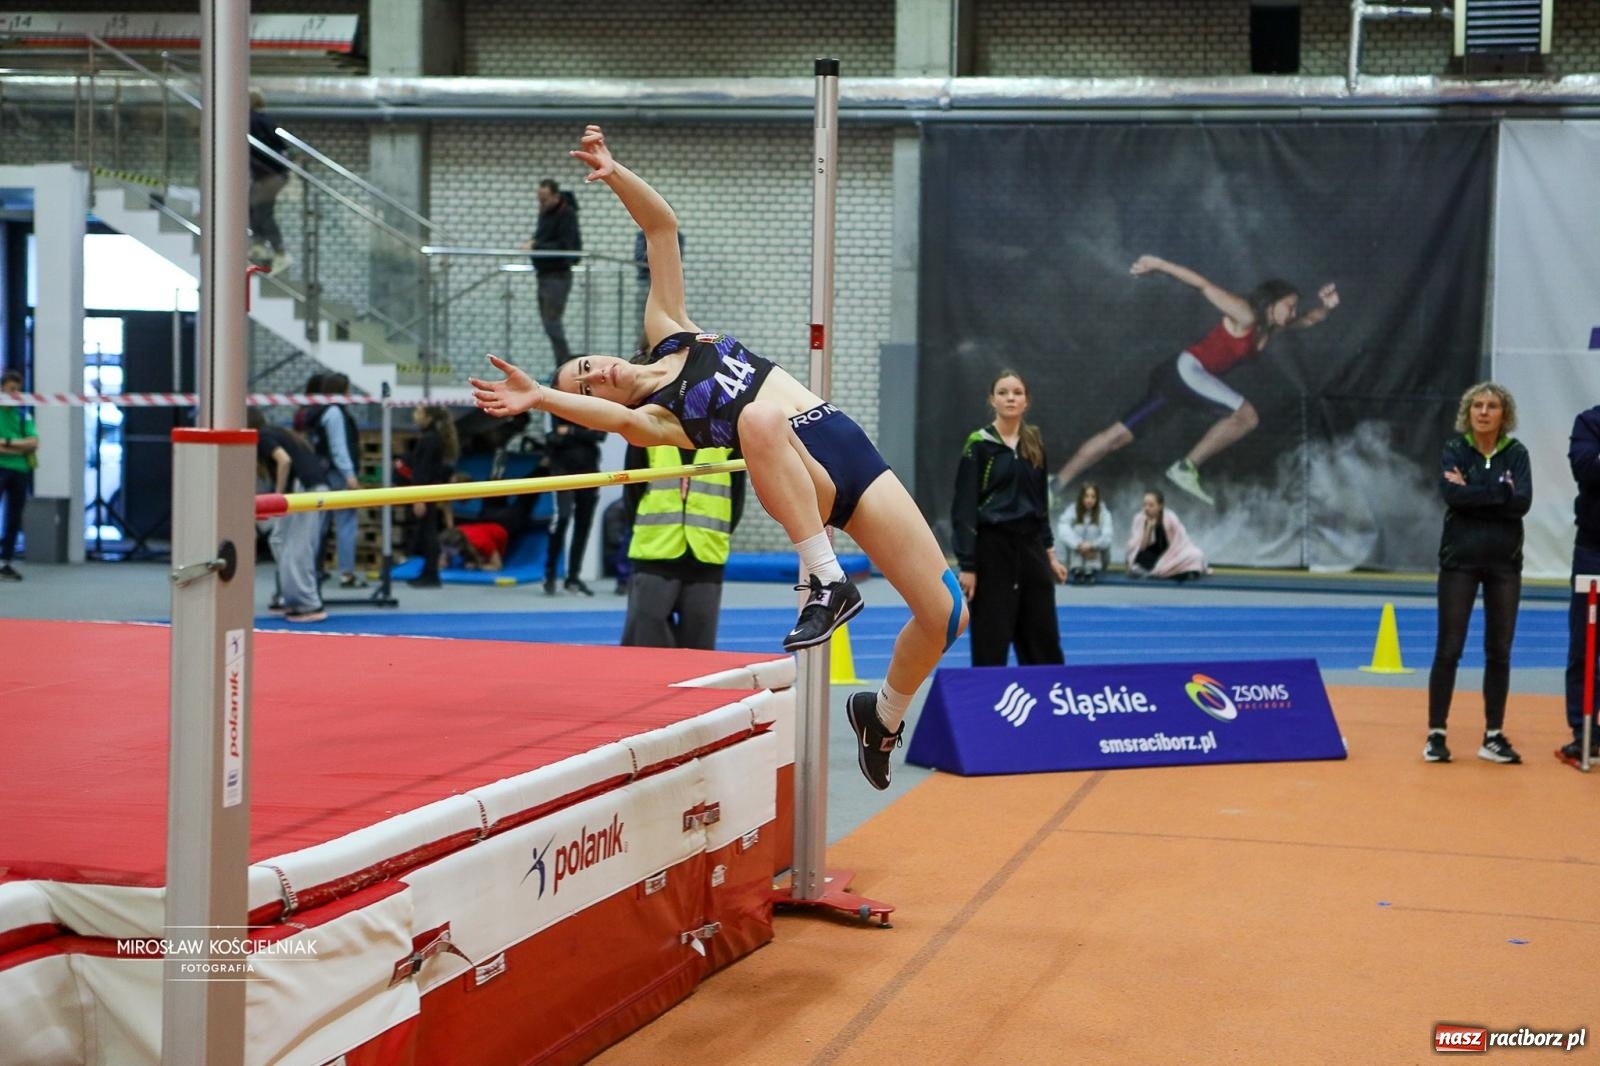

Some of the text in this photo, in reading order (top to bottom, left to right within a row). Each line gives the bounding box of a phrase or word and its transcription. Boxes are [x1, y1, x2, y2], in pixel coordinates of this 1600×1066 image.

[13, 15, 33, 28] 14
[713, 354, 756, 400] 44
[1048, 682, 1158, 722] Śląskie.
[1231, 684, 1290, 702] ZSOMS
[228, 670, 240, 758] polanik
[1099, 731, 1217, 754] smsraciborz.pl
[553, 812, 625, 896] polanik
